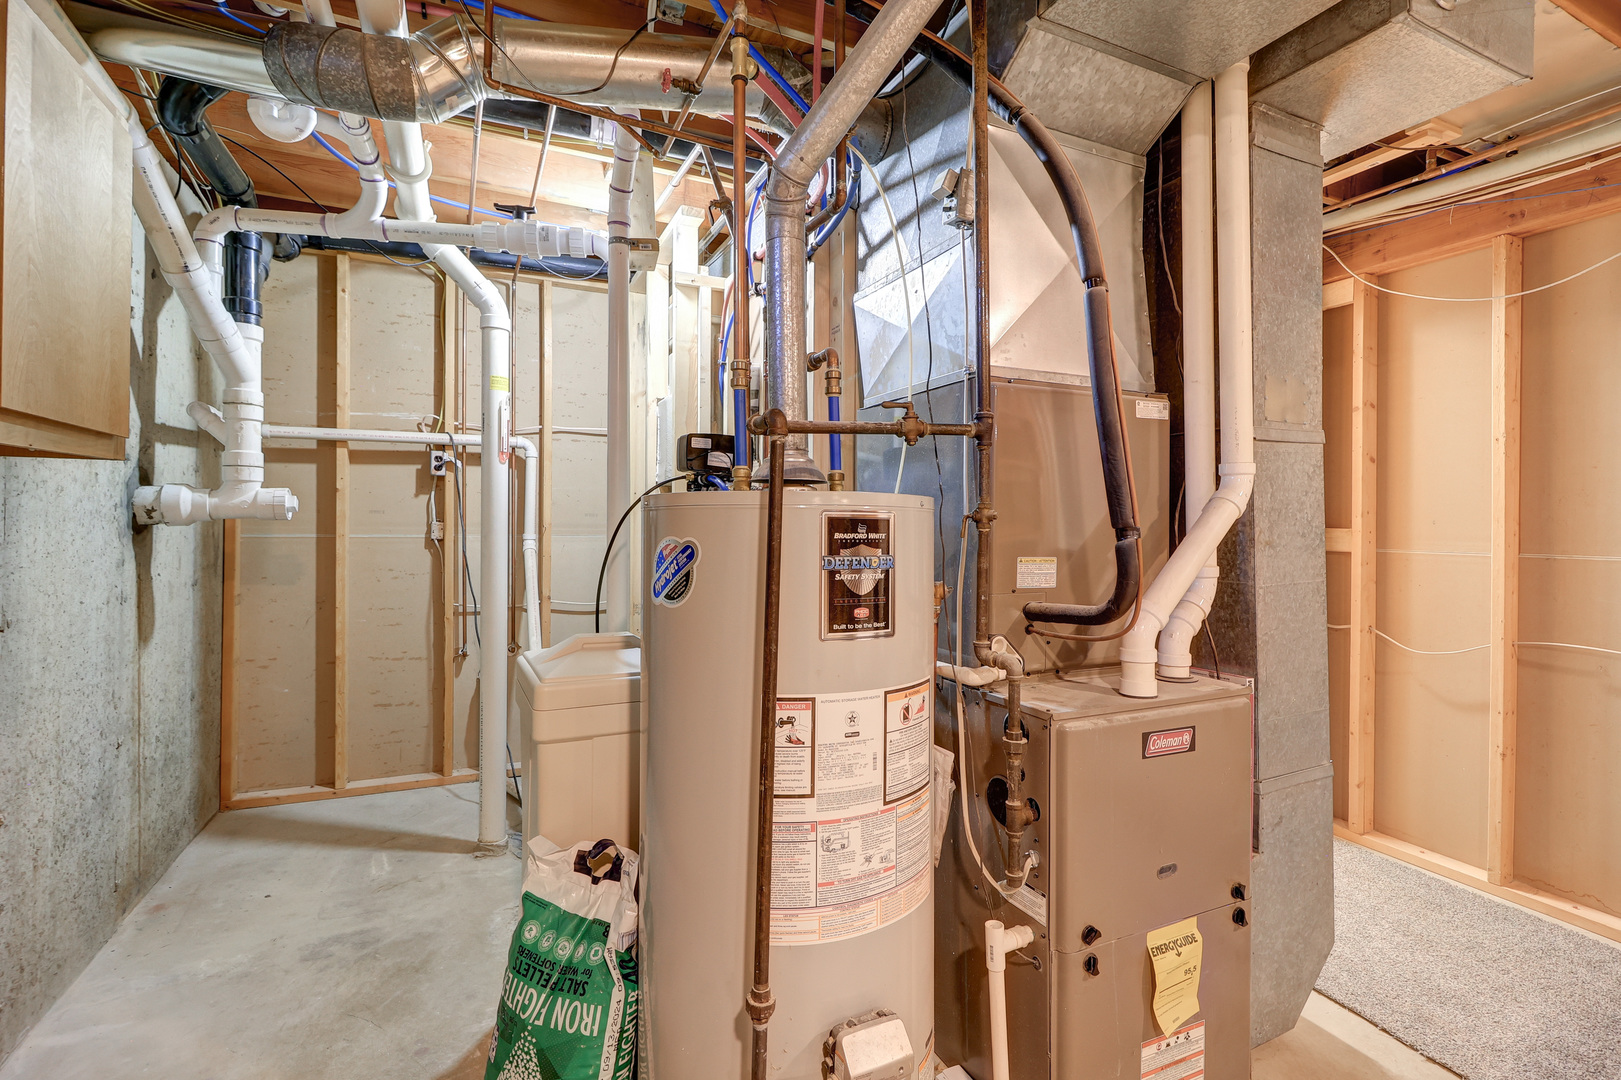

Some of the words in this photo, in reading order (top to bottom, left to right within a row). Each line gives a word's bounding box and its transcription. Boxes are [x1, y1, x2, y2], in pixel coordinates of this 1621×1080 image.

[823, 554, 894, 570] DEFENDER
[654, 559, 679, 594] Hydrojet
[1149, 736, 1183, 750] Coleman
[517, 945, 557, 972] SOFTENERS
[1151, 933, 1198, 958] ENERGYGUIDE
[512, 956, 558, 992] PELLETS
[581, 967, 593, 979] for
[502, 971, 552, 1025] FIGHTE
[558, 976, 589, 997] SALT
[550, 996, 602, 1036] IRON
